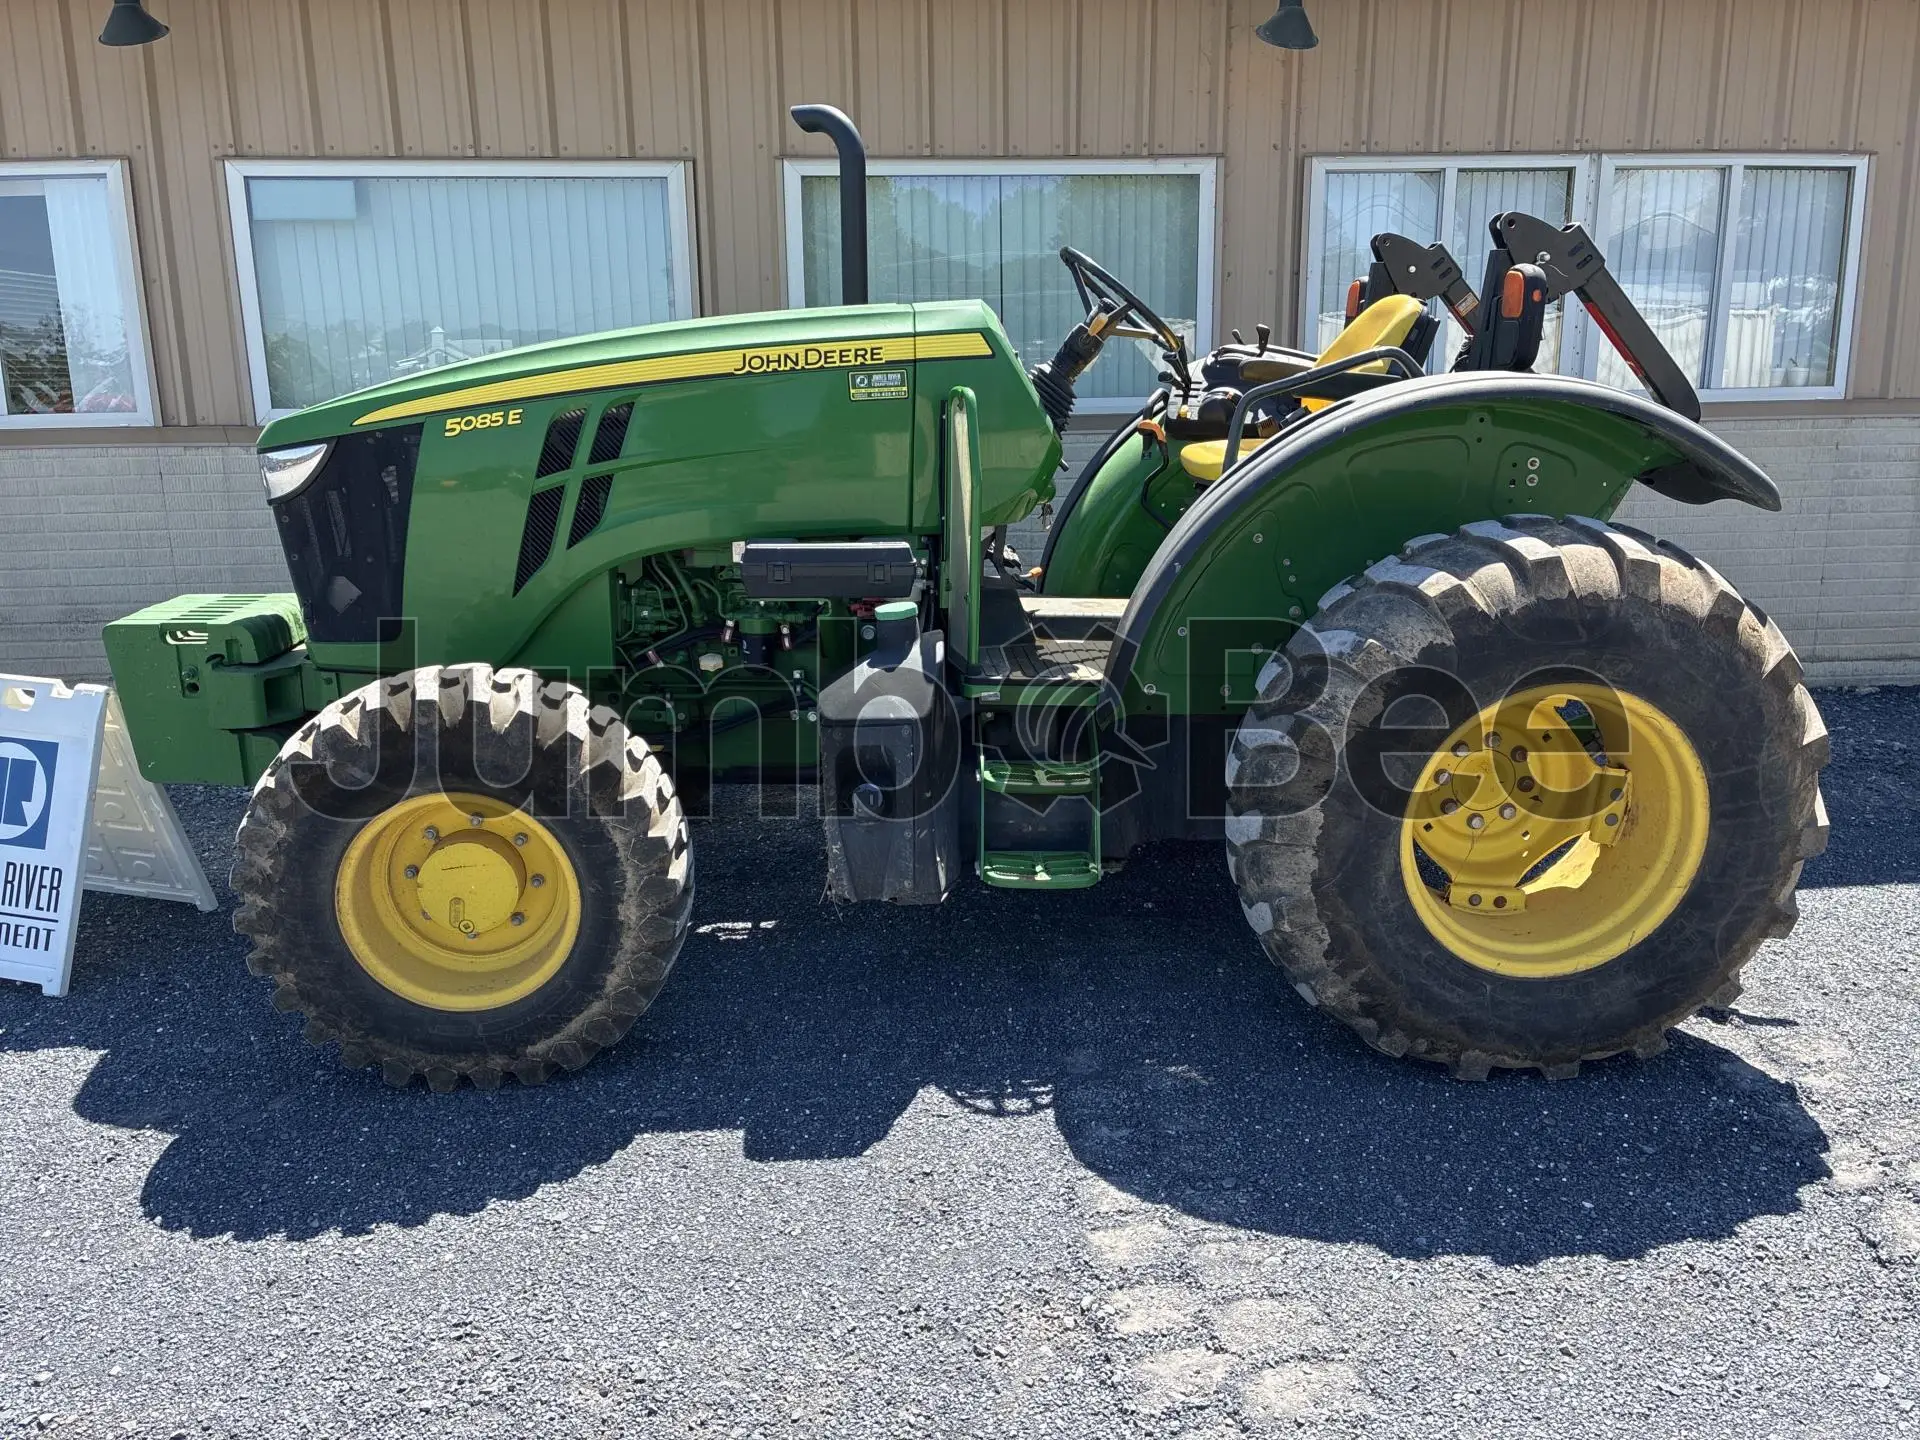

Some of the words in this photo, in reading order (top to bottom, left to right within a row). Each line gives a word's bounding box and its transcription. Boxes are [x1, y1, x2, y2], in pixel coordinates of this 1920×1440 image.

[733, 352, 799, 373] JOHN
[804, 346, 884, 367] DEERE
[444, 411, 504, 437] 5085
[507, 408, 523, 425] E
[1, 860, 63, 914] RIVER
